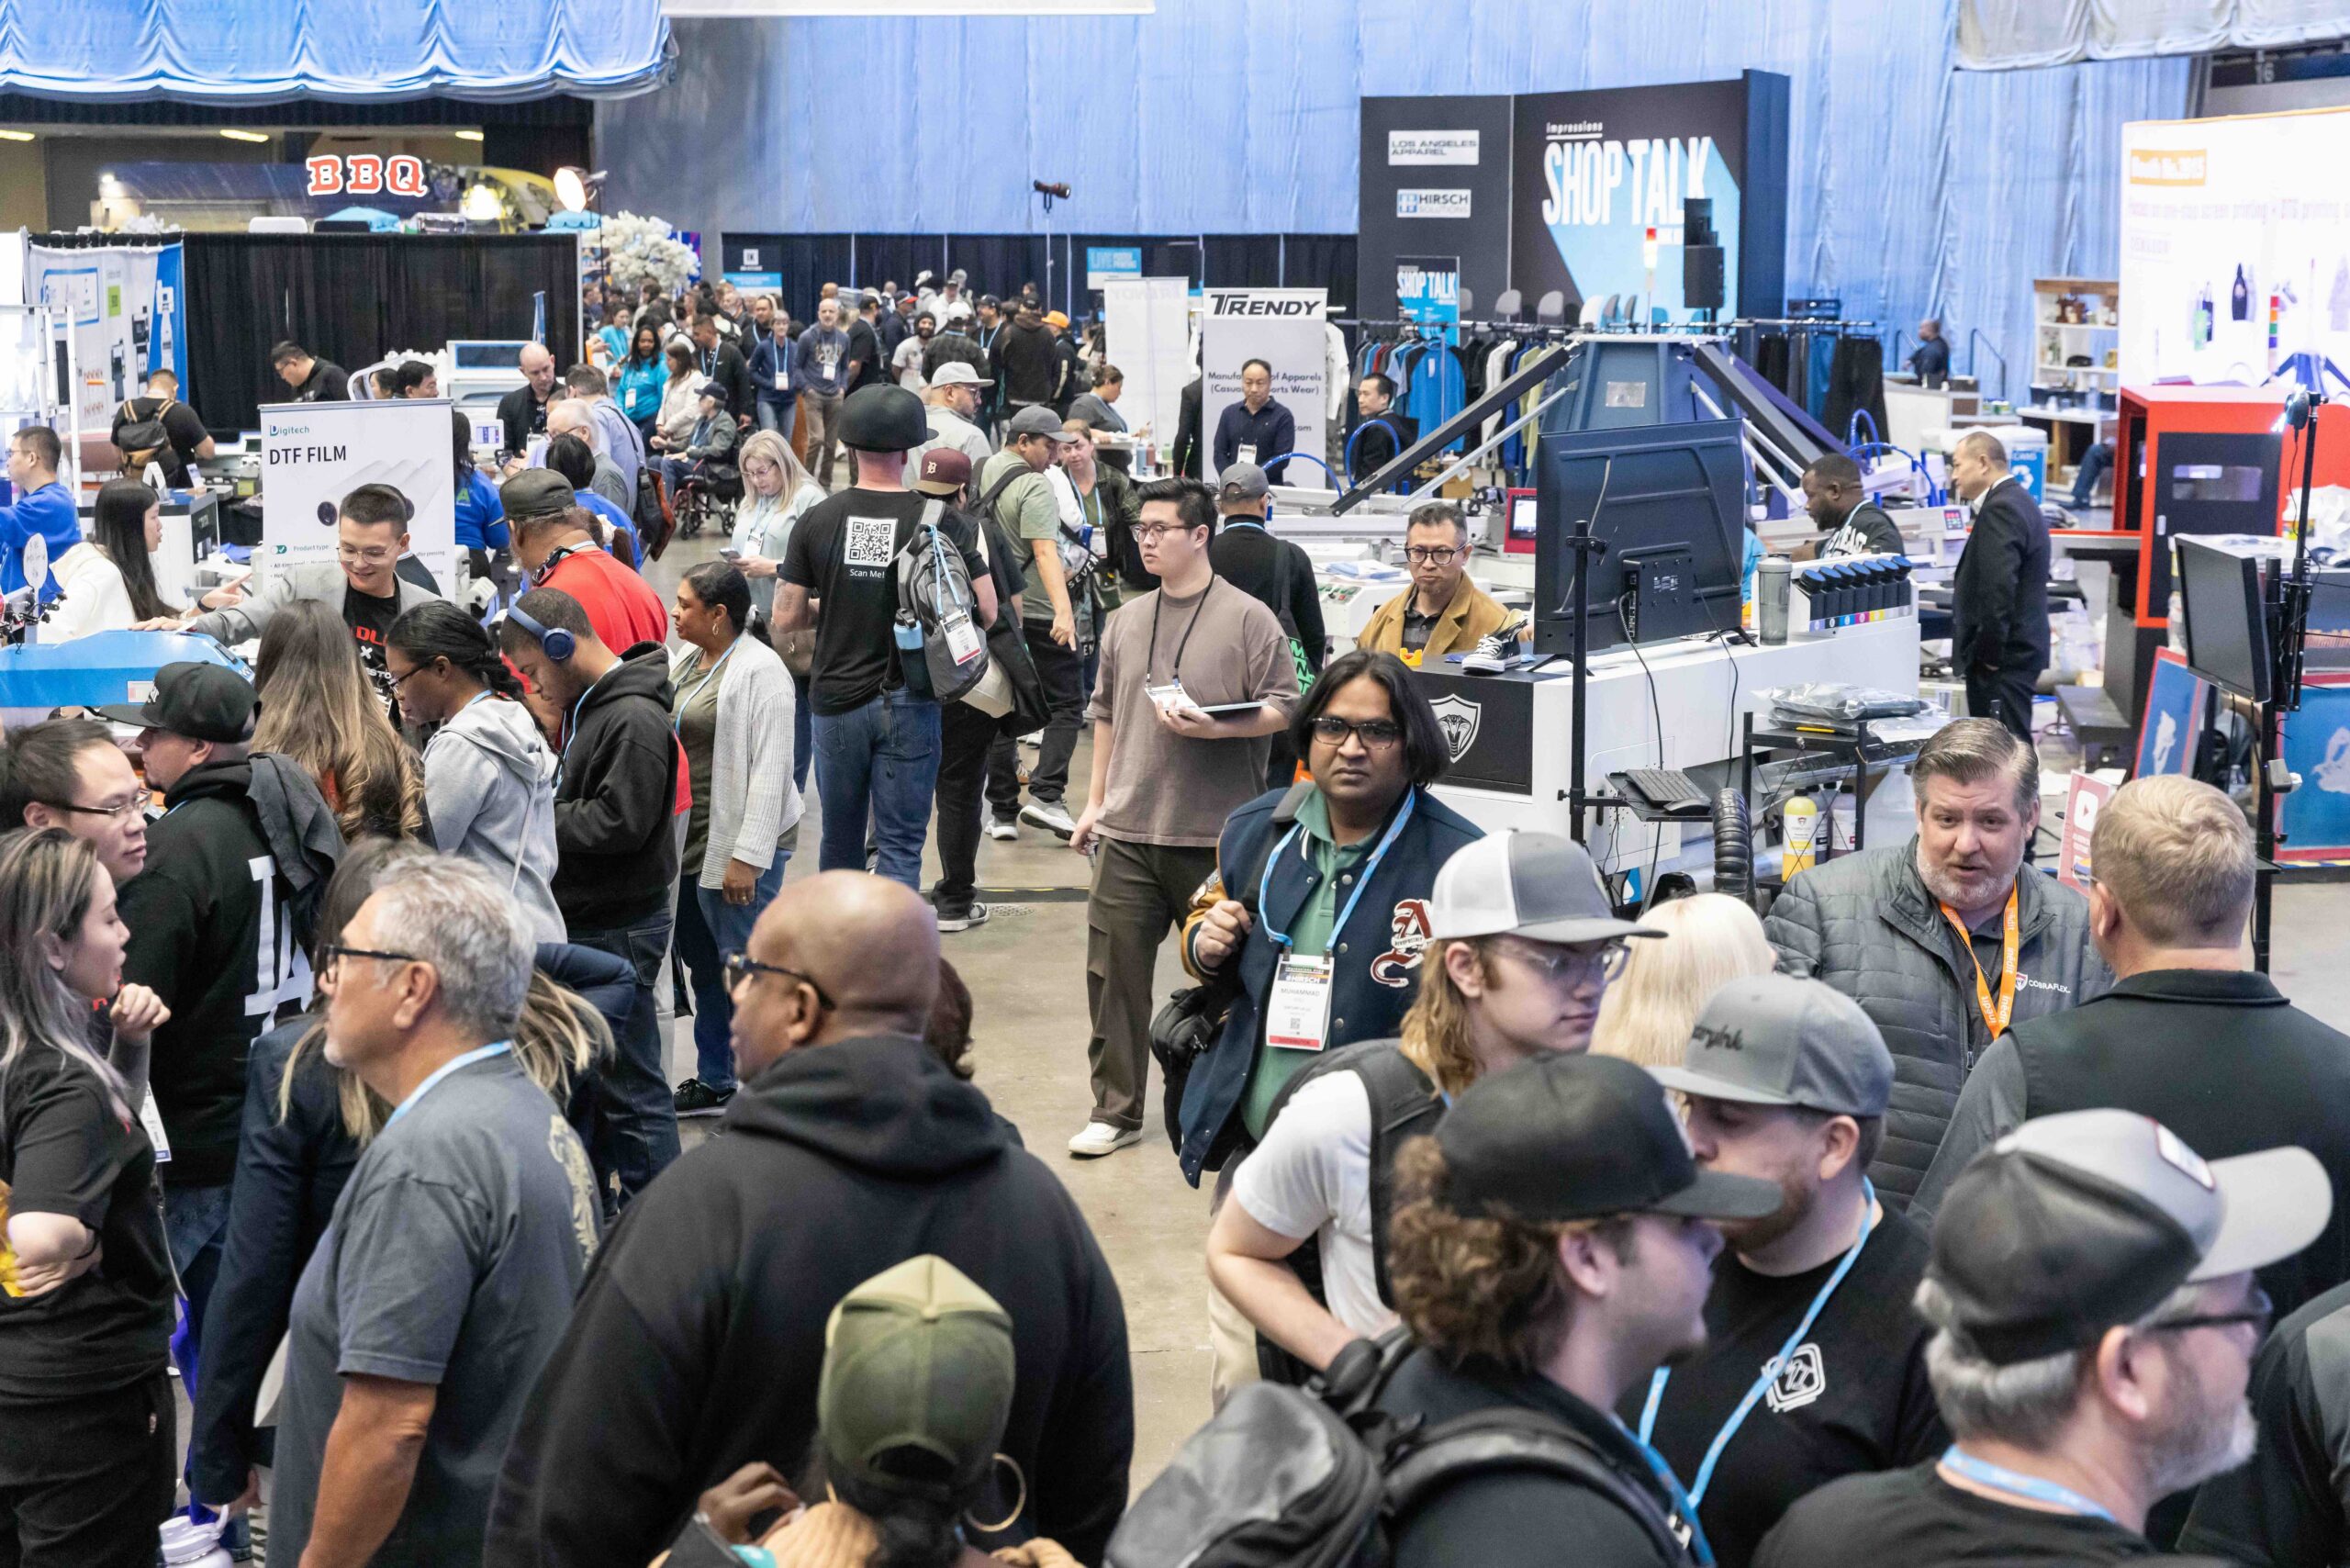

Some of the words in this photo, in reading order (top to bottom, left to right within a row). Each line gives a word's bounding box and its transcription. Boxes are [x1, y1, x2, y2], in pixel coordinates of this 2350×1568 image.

[1546, 120, 1603, 135] impressions
[1392, 148, 1447, 156] APPAREL
[306, 154, 429, 197] BBQ
[1541, 140, 1623, 226] SHOP
[1627, 136, 1712, 226] TALK
[1419, 194, 1469, 205] HIRSCH
[1396, 271, 1427, 298] SHOP
[1427, 271, 1456, 298] TALK
[1210, 294, 1322, 316] TRENDY
[1281, 372, 1322, 383] Apparels
[1291, 386, 1319, 395] Wear)
[269, 425, 310, 436] Digitech
[270, 447, 302, 465] DTF
[308, 445, 346, 464] FILM
[849, 568, 867, 577] Scan
[869, 570, 885, 578] Me!
[1068, 554, 1099, 588] SEVEN
